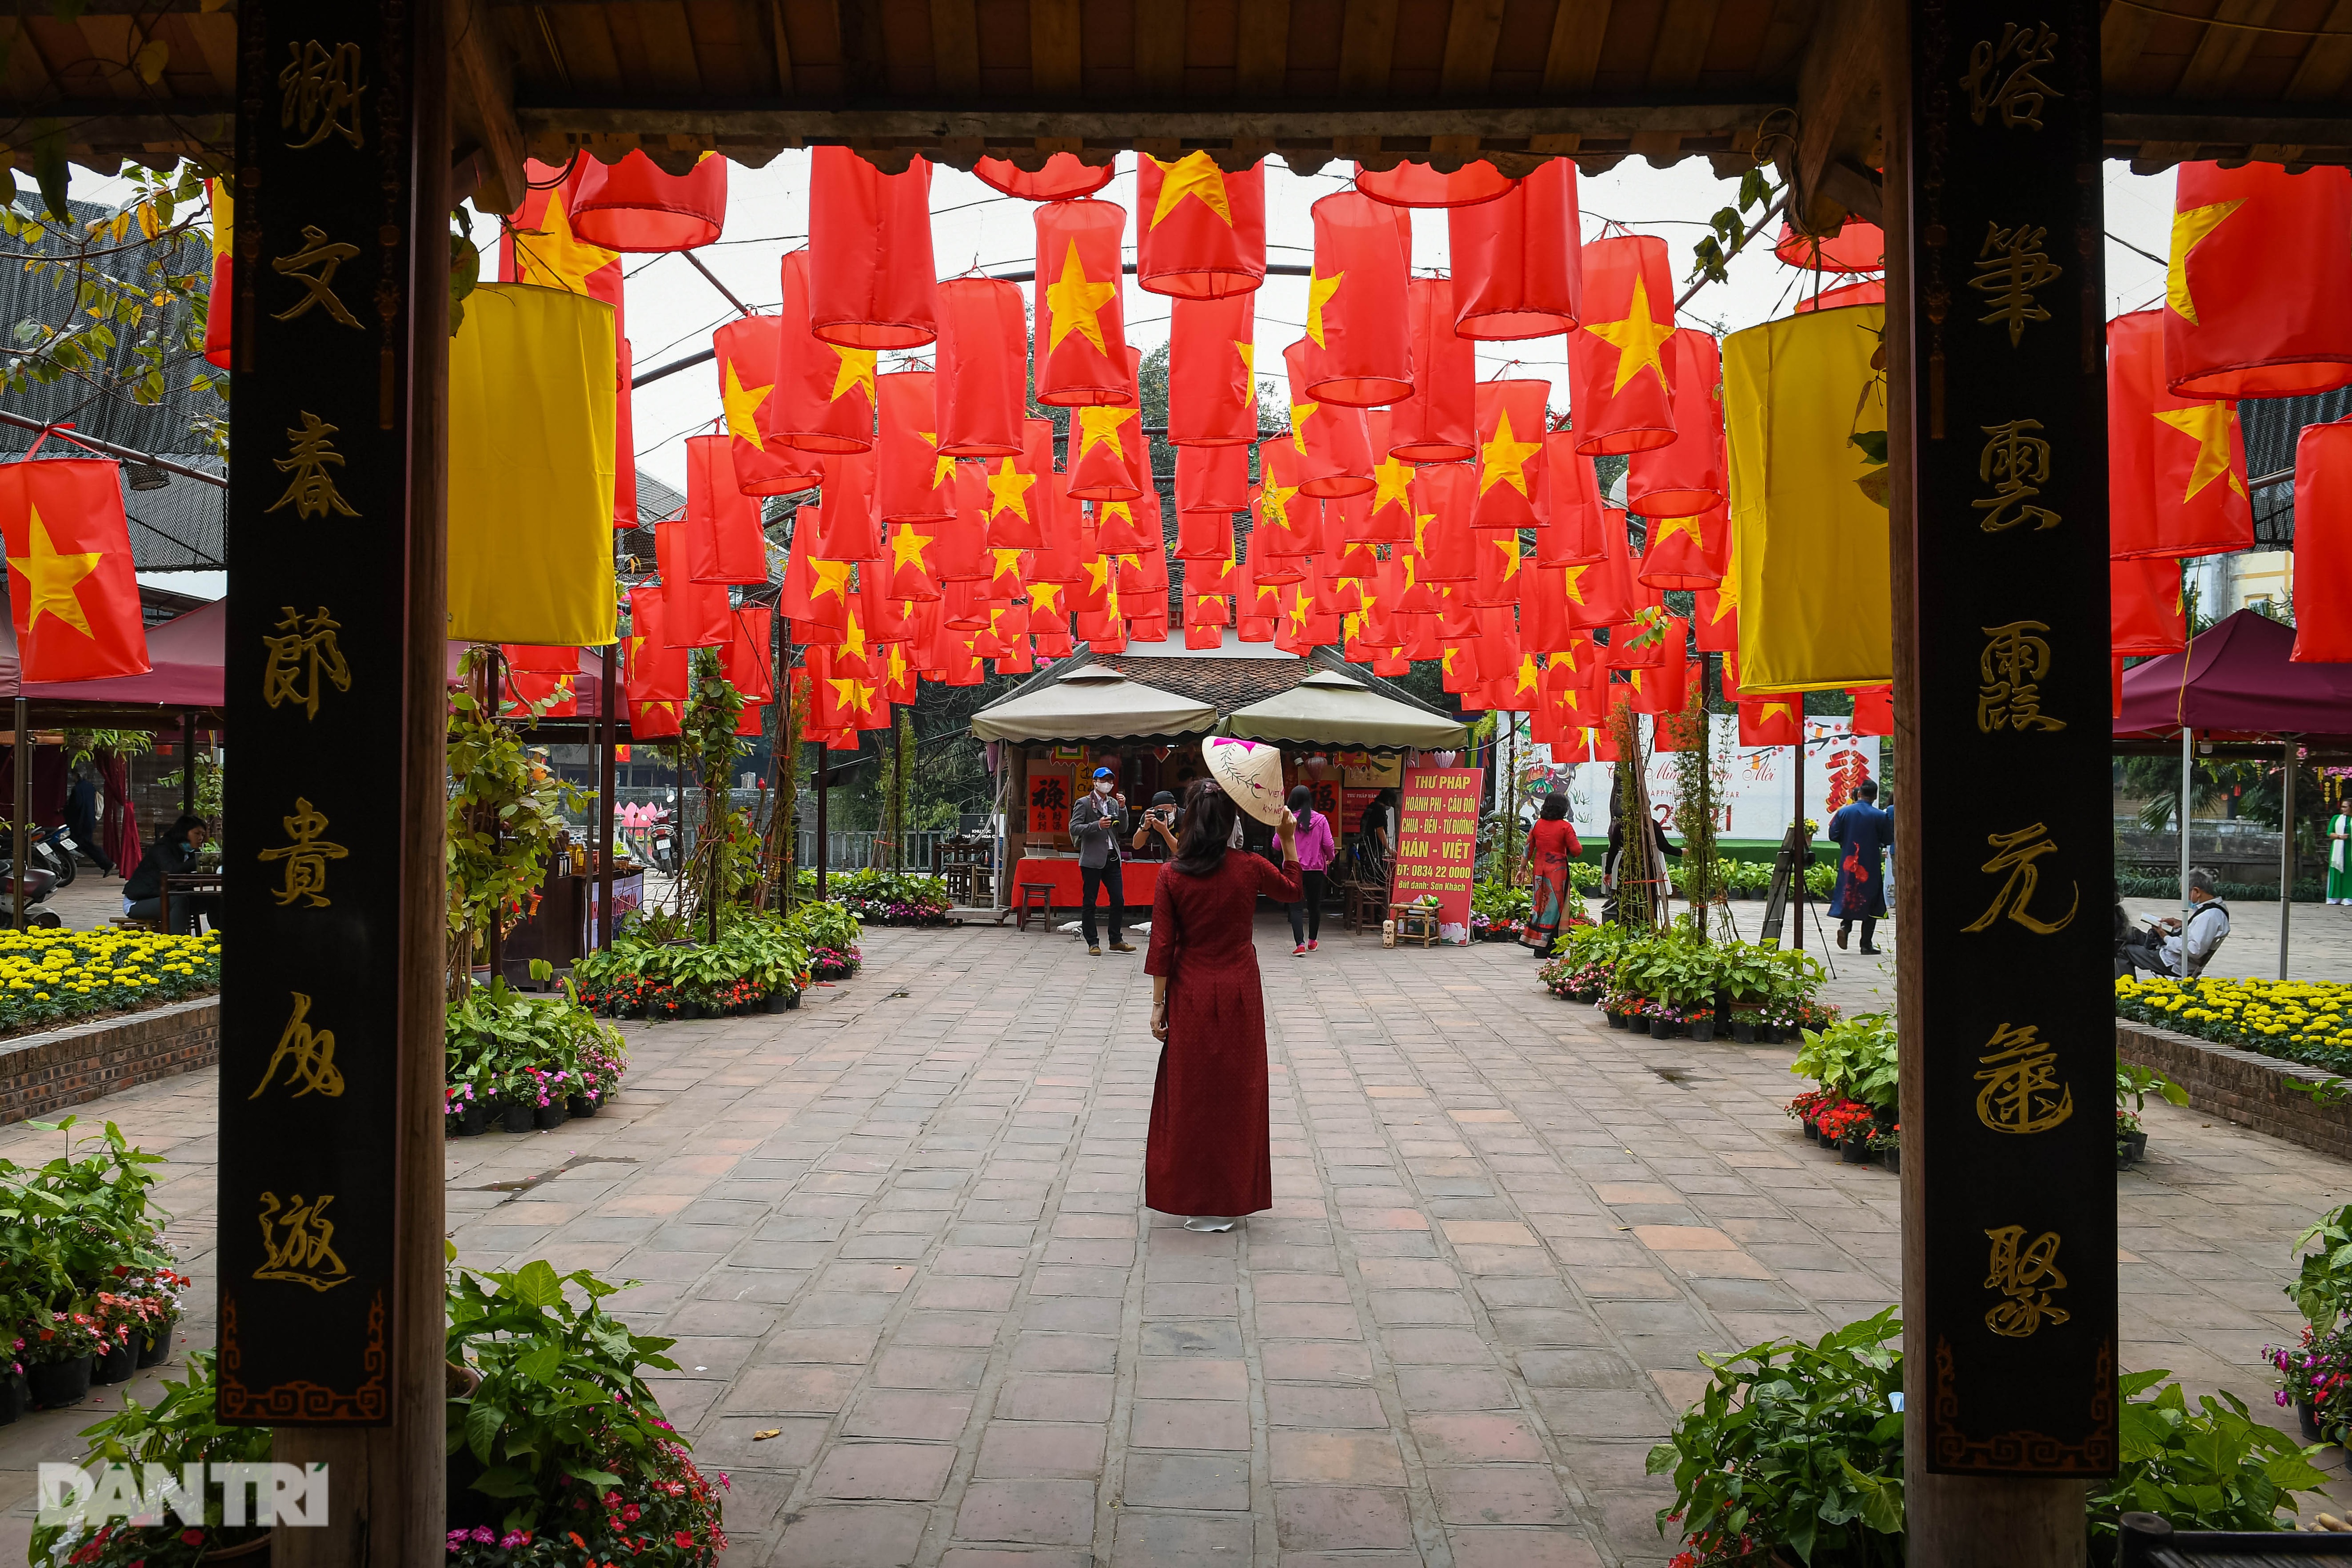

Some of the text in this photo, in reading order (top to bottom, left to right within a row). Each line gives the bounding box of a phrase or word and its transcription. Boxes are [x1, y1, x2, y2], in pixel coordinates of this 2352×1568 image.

[1742, 762, 1776, 781] Mới
[1414, 774, 1471, 789] THƯ PHÁP
[1405, 793, 1429, 811] HOÀNH
[1430, 797, 1442, 812] PHI
[1448, 794, 1462, 812] CÂU
[1463, 792, 1476, 813] ĐỐI
[1402, 815, 1418, 833] CHÙA
[1443, 816, 1452, 834] TỪ
[1452, 816, 1474, 835] ĐƯỜNG
[1653, 804, 1732, 832] 221
[1400, 838, 1429, 857] HÁN
[1442, 839, 1470, 863] VIỆT
[1412, 864, 1433, 877] 0834
[1435, 865, 1446, 878] 22
[1449, 866, 1470, 879] 0000
[1398, 880, 1466, 892] Bút danh: Sơn Khách
